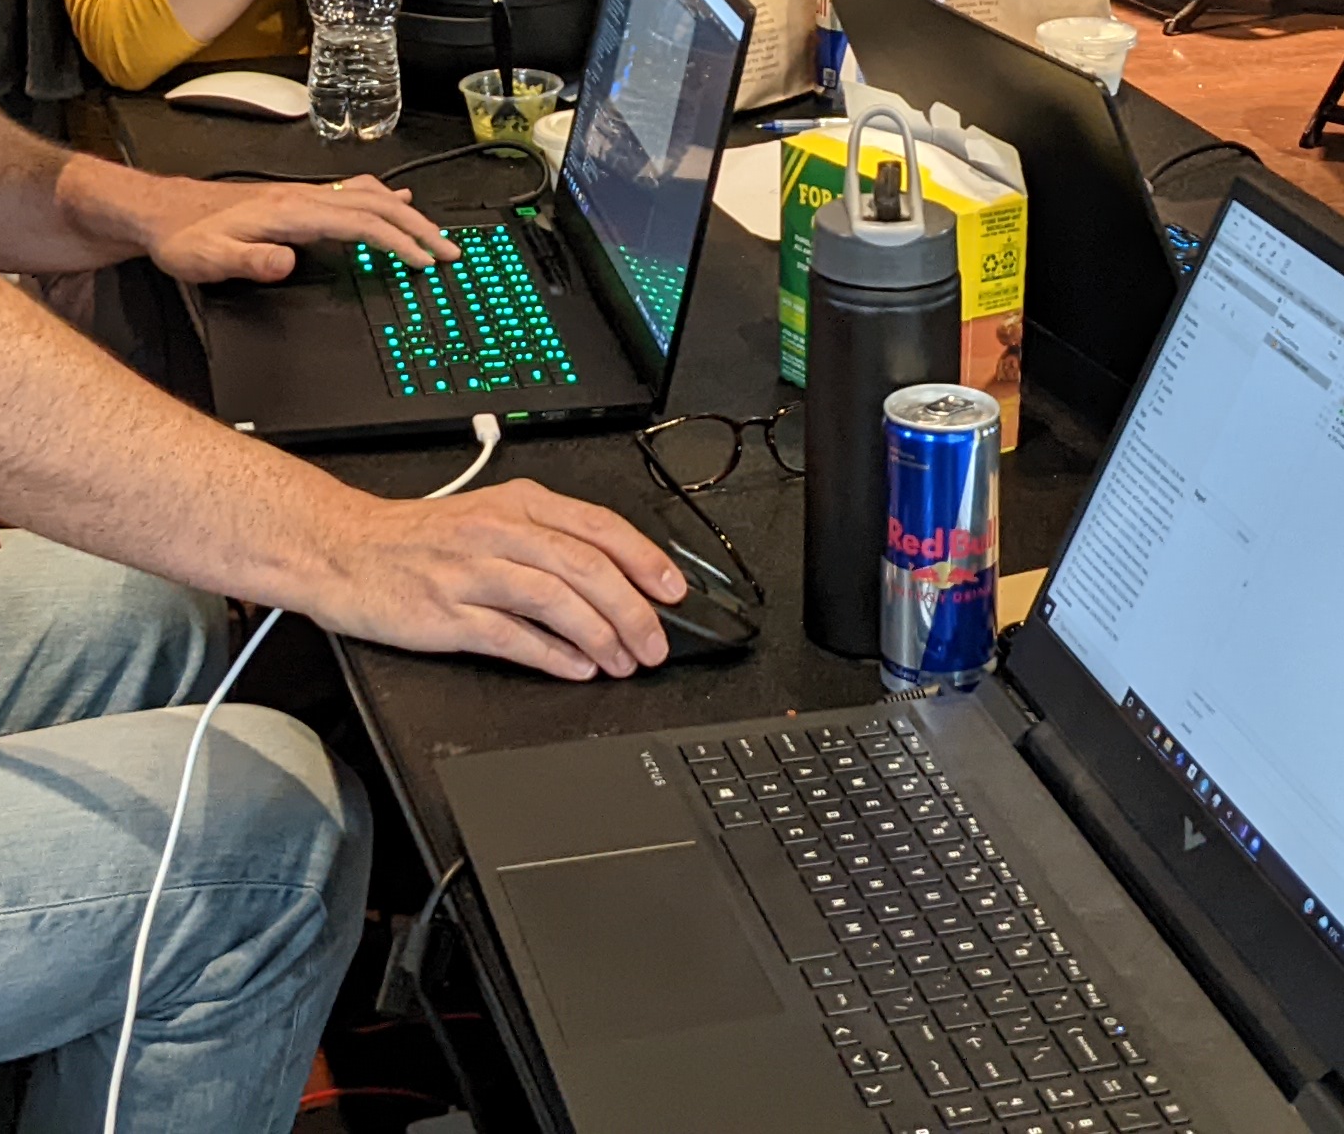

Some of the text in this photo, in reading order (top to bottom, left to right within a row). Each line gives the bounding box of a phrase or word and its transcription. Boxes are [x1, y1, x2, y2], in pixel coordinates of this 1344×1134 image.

[888, 516, 997, 560] Red Bull
[639, 750, 667, 788] VICTUS
